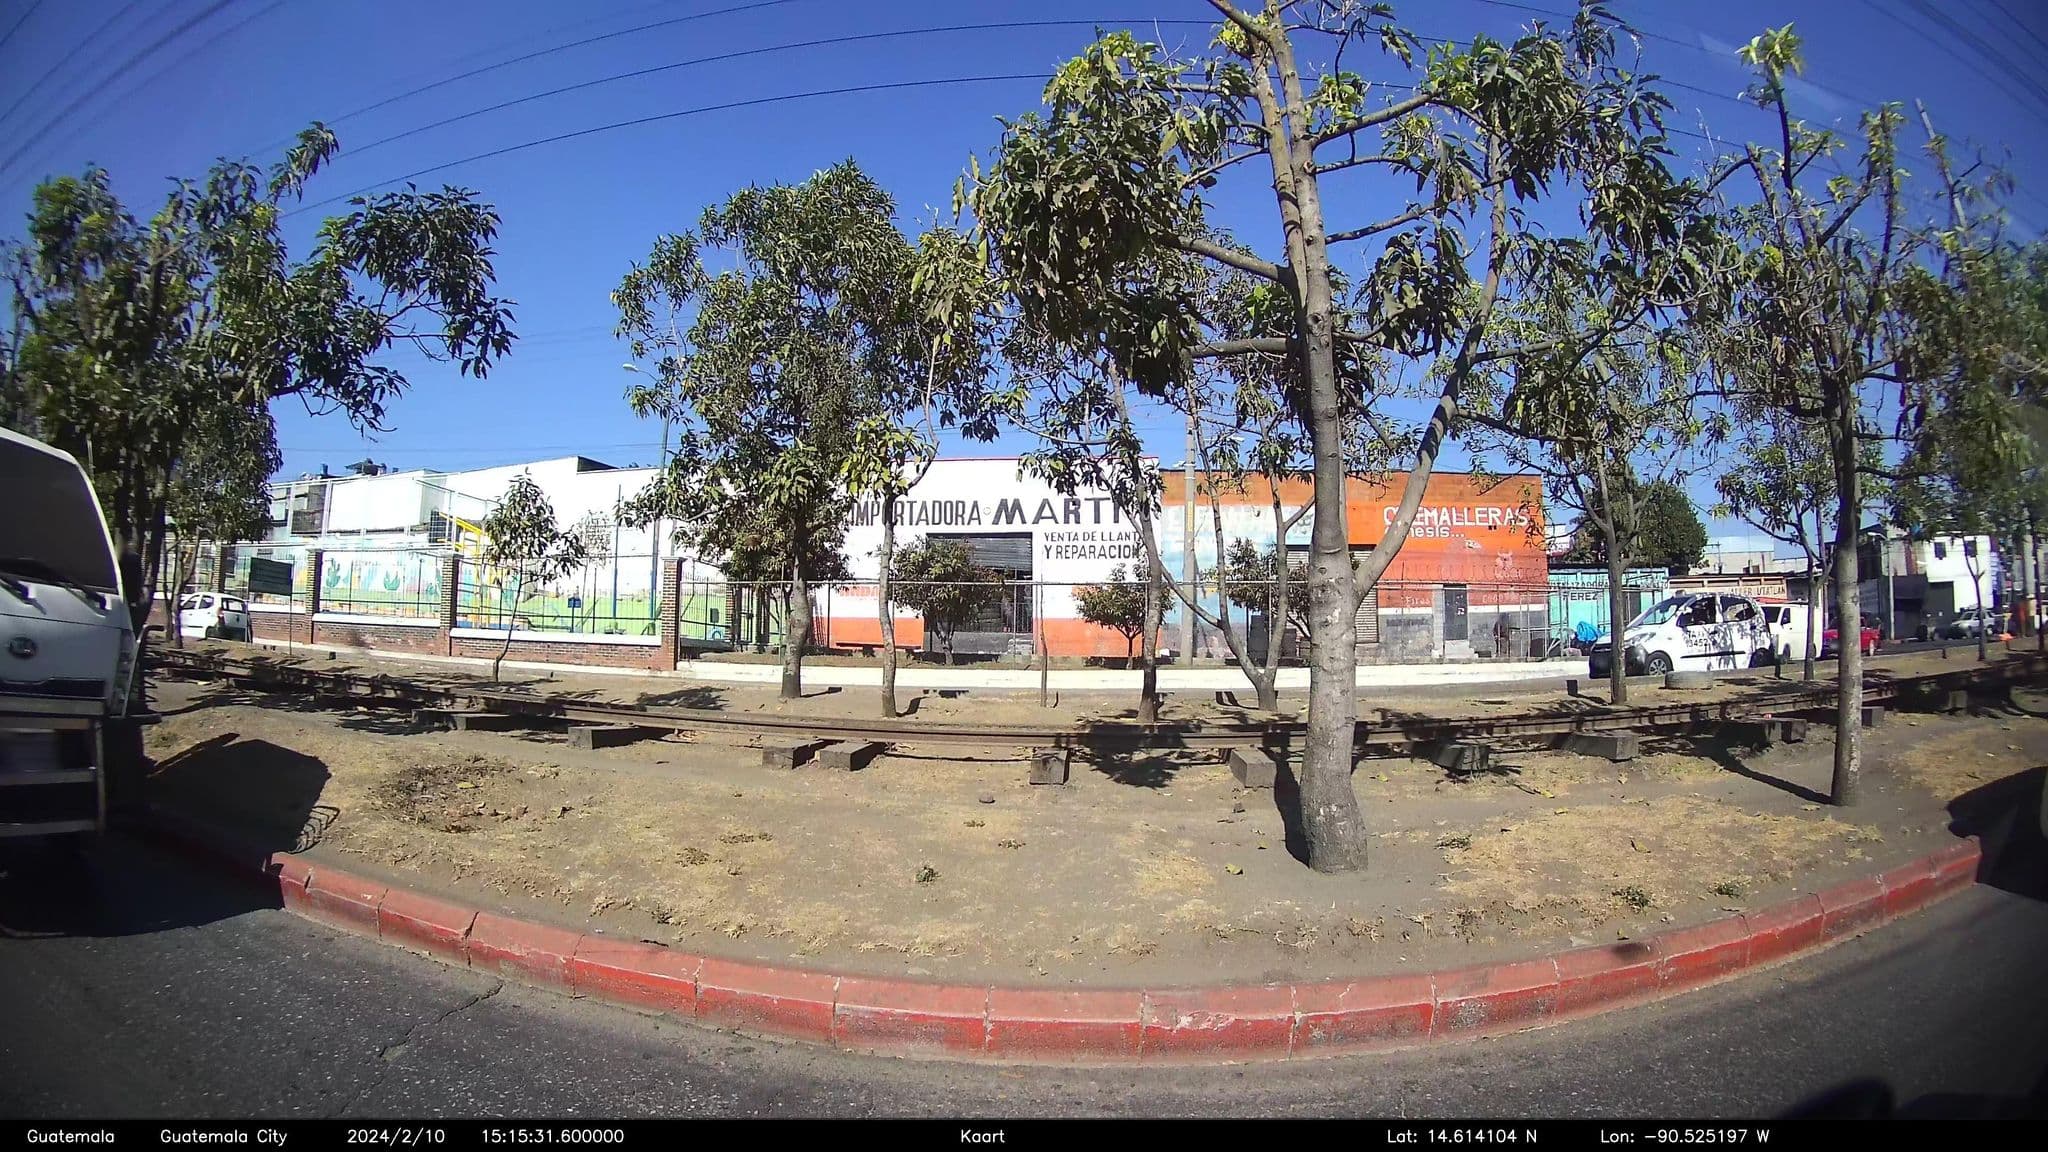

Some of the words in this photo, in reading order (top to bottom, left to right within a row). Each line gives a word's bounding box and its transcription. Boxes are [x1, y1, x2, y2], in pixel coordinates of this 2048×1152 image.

[1383, 506, 1529, 527] CEMALLERAS
[1044, 532, 1079, 542] VENTA
[1083, 531, 1096, 542] DE
[1101, 531, 1138, 542] LLANT
[1044, 545, 1052, 559] Y
